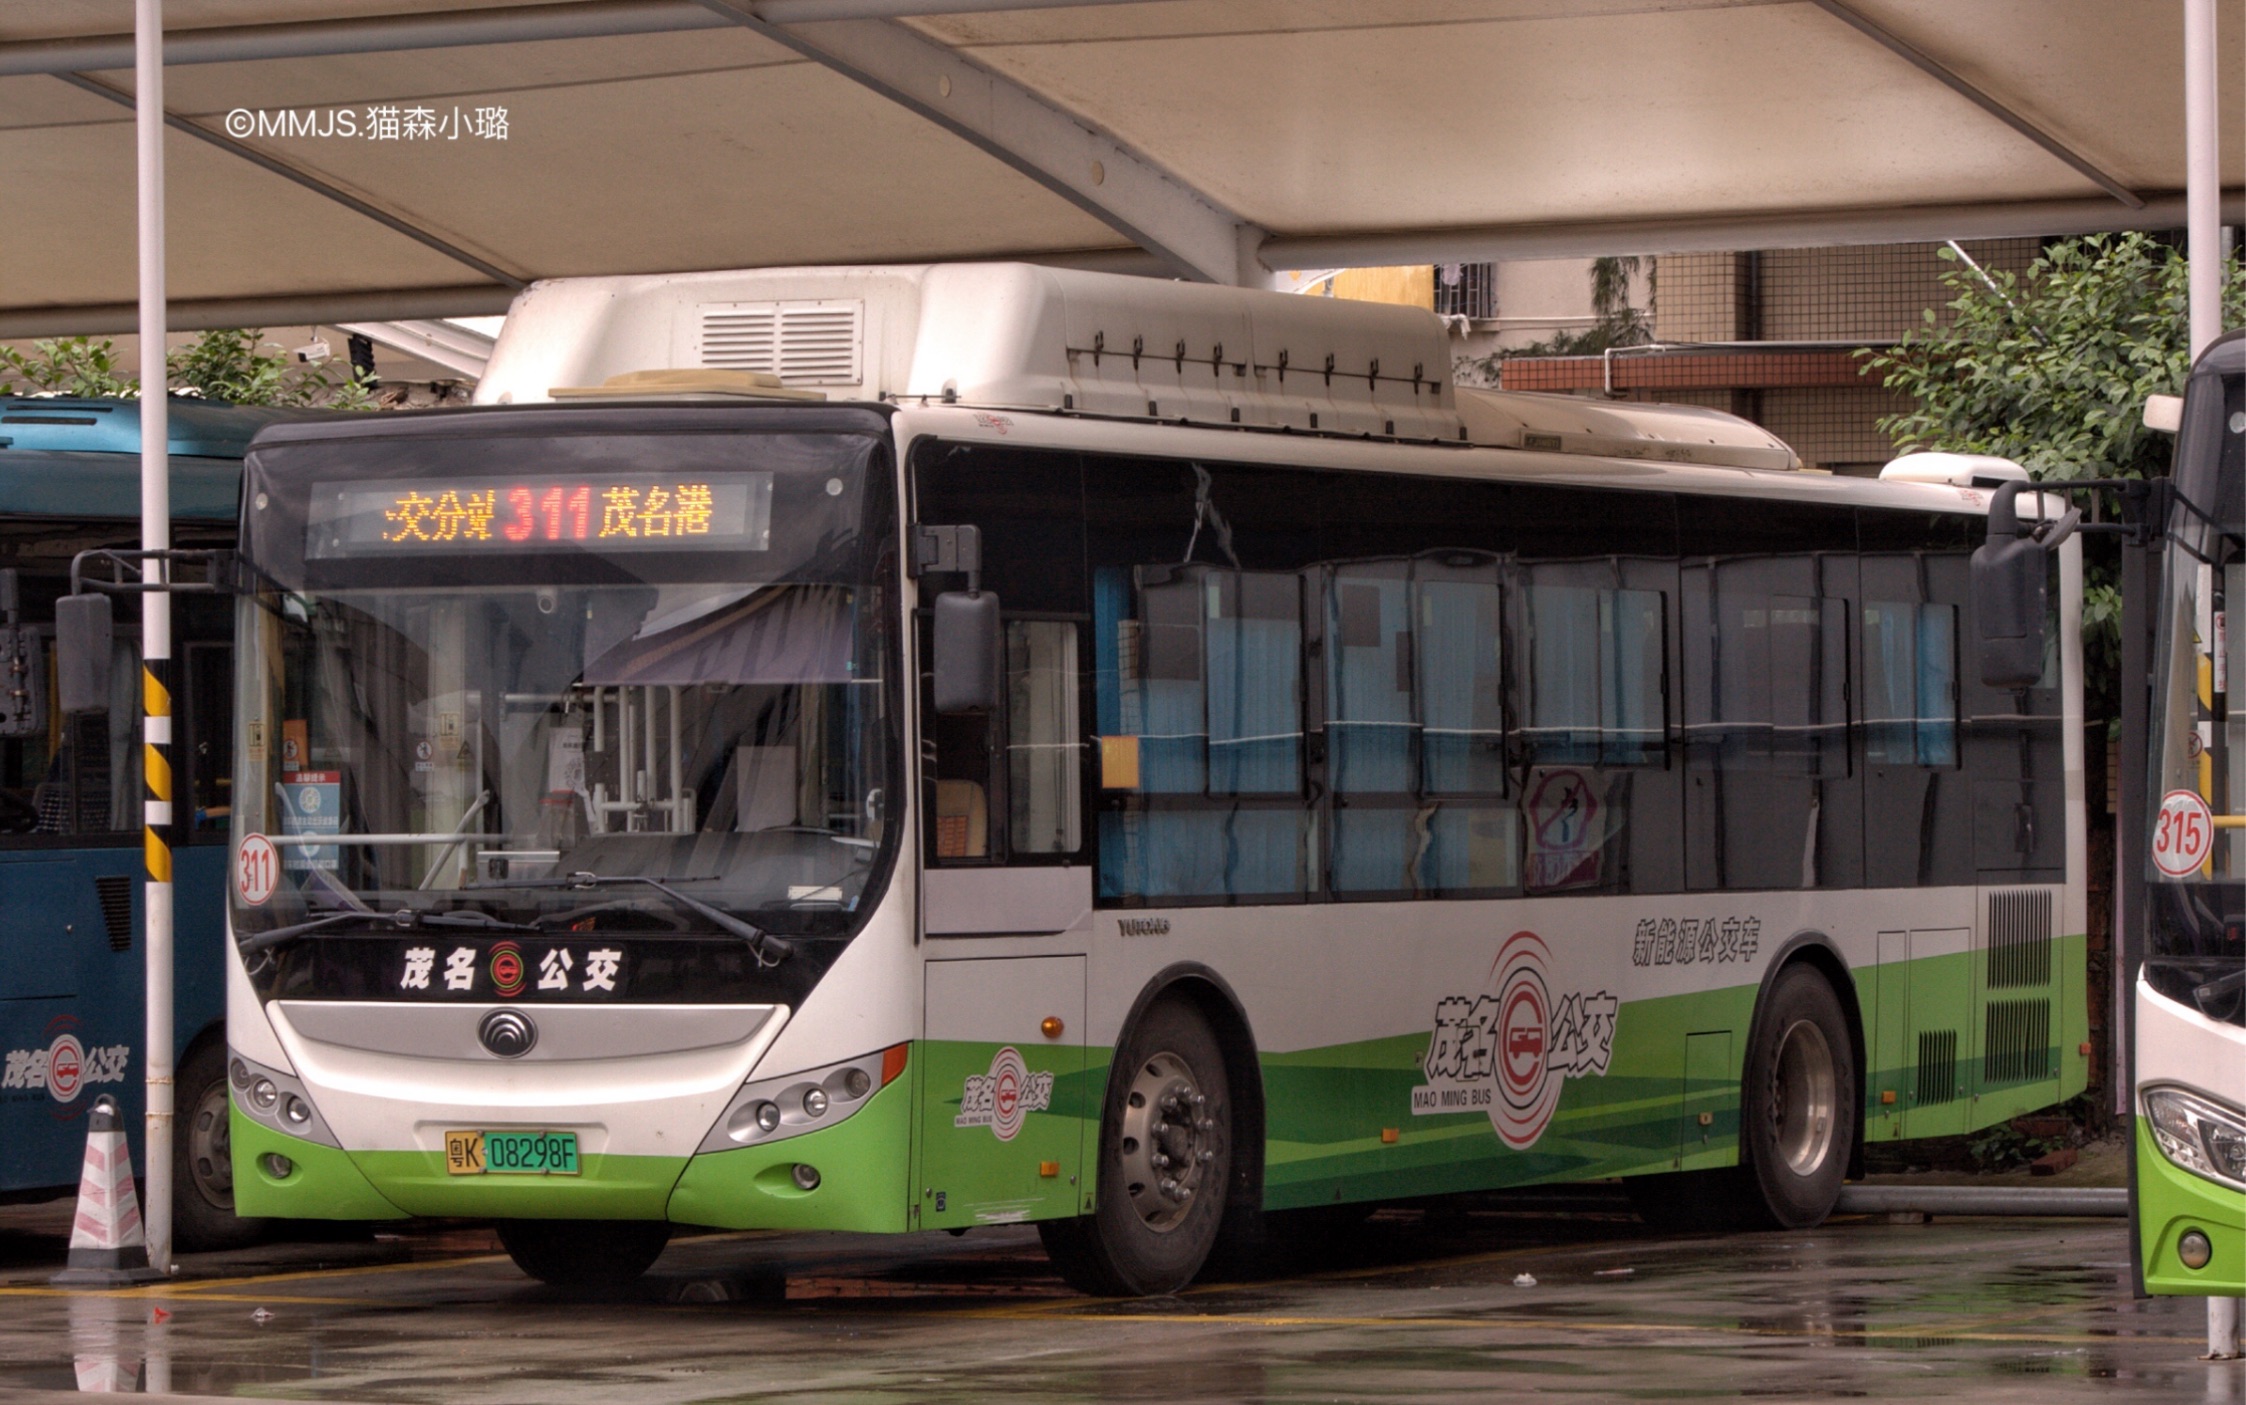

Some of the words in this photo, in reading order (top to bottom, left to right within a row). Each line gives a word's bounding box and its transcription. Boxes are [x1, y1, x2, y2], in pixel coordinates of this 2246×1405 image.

[505, 486, 591, 541] 311
[599, 484, 713, 537] 茂名港
[2156, 808, 2202, 856] 315
[240, 849, 271, 893] 311
[1632, 915, 1761, 966] 新能源公交车
[400, 947, 476, 991] 茂名
[537, 948, 622, 992] 公交
[1413, 1091, 1437, 1109] MAO
[1441, 1089, 1467, 1107] MING
[1471, 1088, 1492, 1105] BUS
